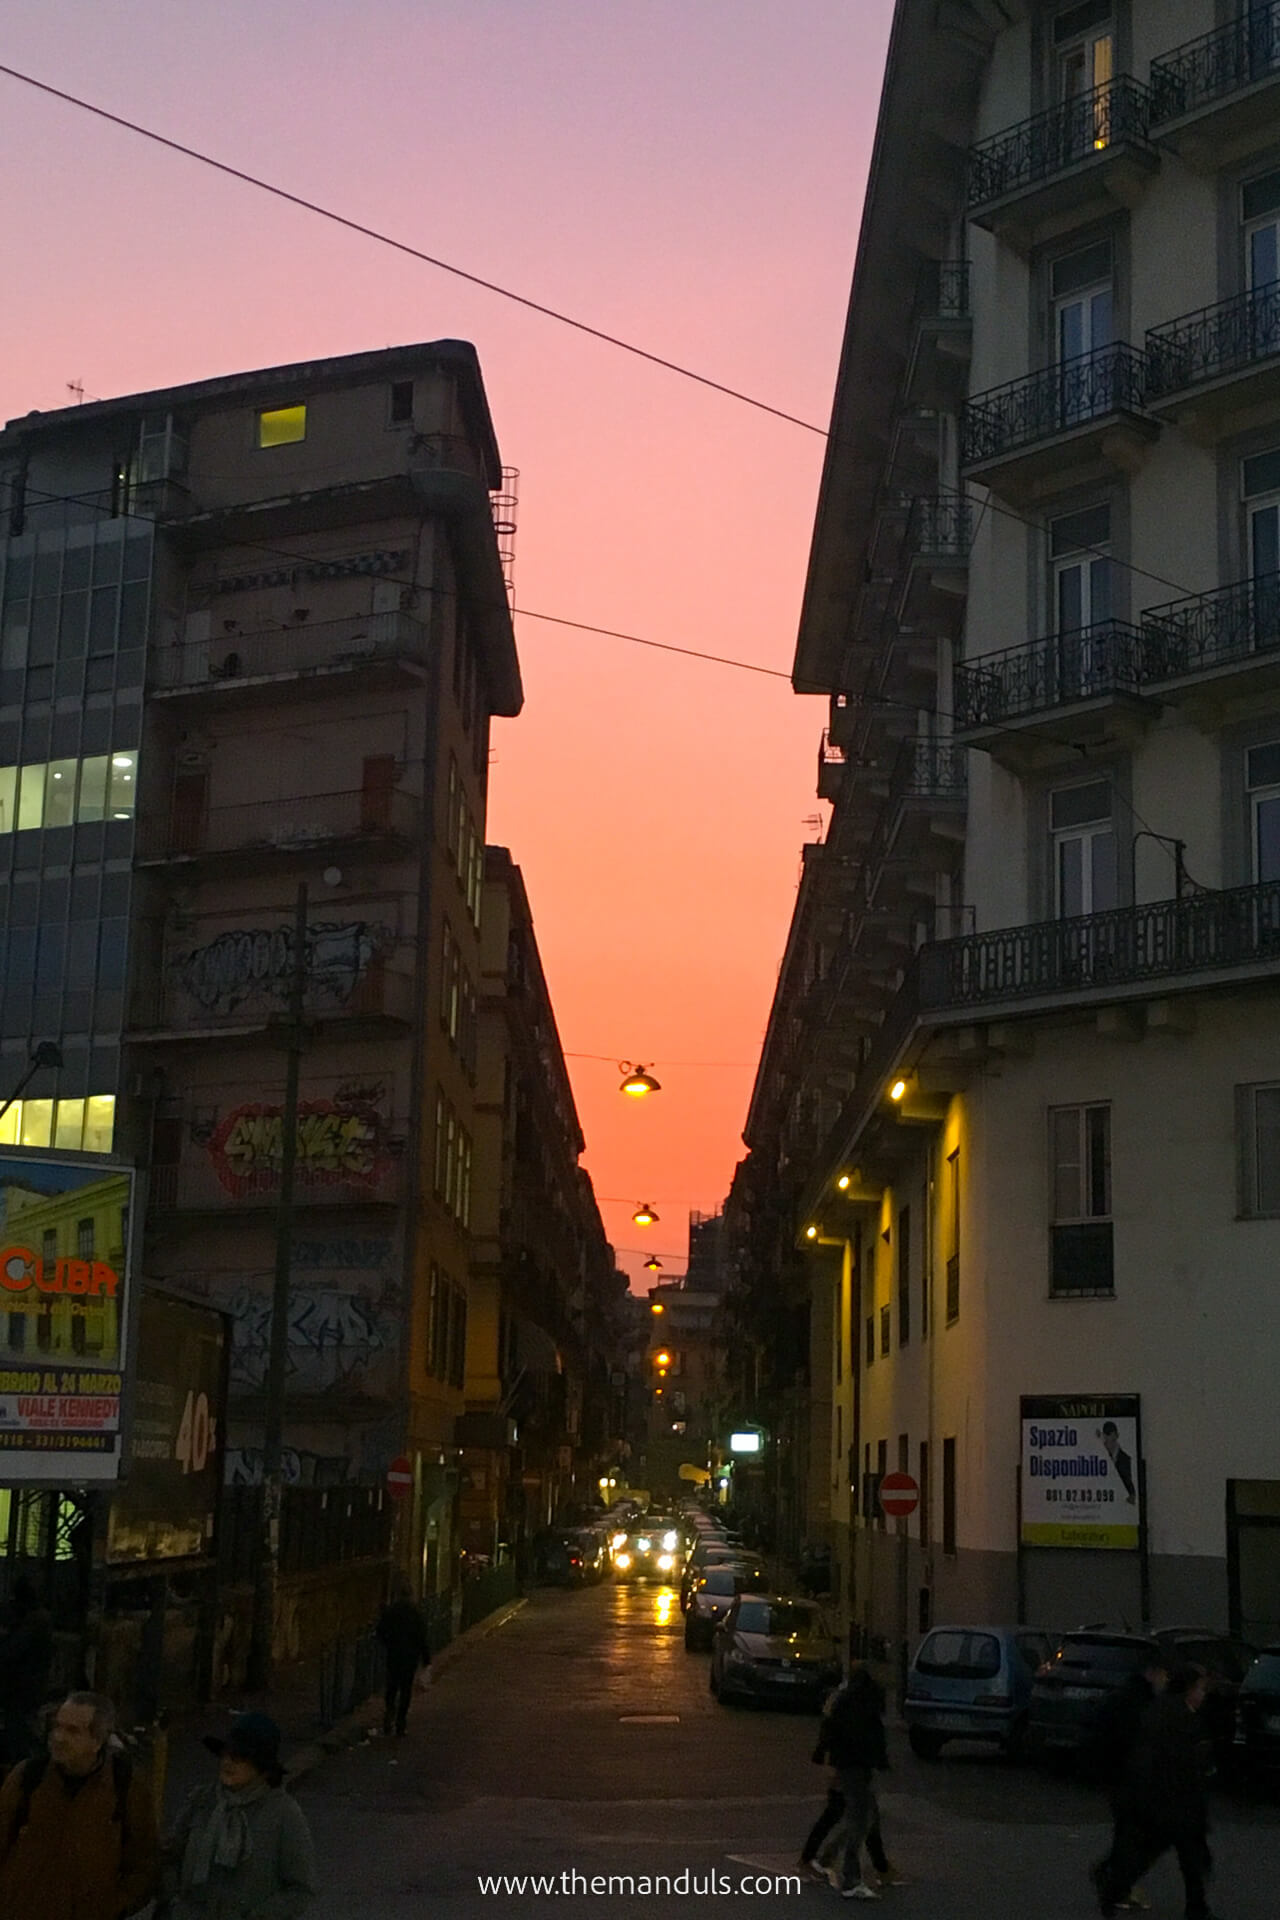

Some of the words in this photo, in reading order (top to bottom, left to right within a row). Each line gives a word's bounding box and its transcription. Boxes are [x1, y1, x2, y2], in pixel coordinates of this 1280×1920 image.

[0, 1246, 119, 1297] CUBA
[18, 1398, 55, 1417] VIALE
[58, 1399, 118, 1418] KENNEDY
[1030, 1425, 1077, 1449] Spazio
[1030, 1455, 1108, 1479] Disponibile
